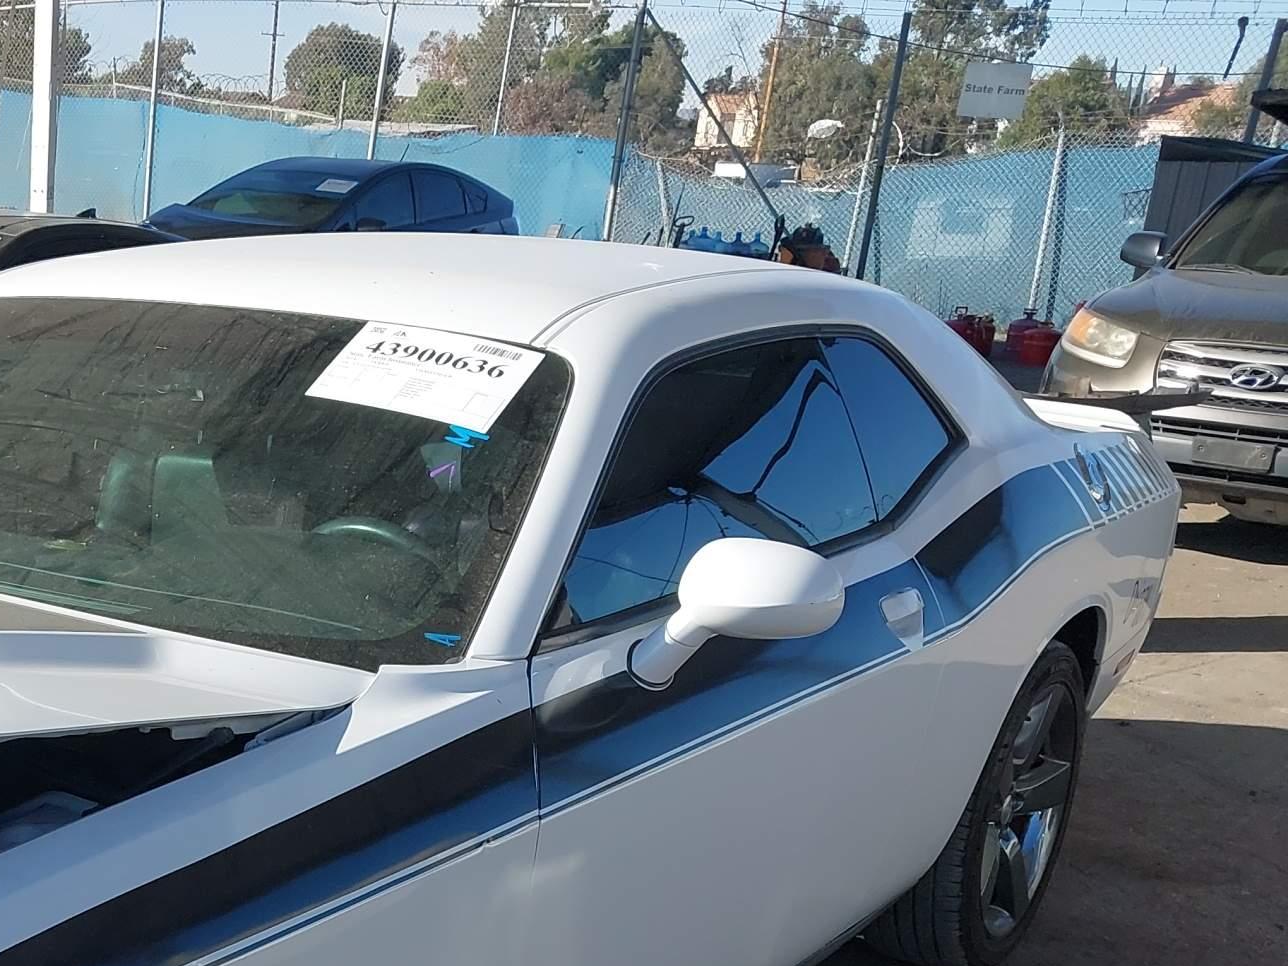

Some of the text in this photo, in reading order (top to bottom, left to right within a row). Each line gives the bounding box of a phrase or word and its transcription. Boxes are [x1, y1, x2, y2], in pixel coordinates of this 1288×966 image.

[964, 83, 1026, 96] State Farm
[365, 340, 509, 379] 43900636
